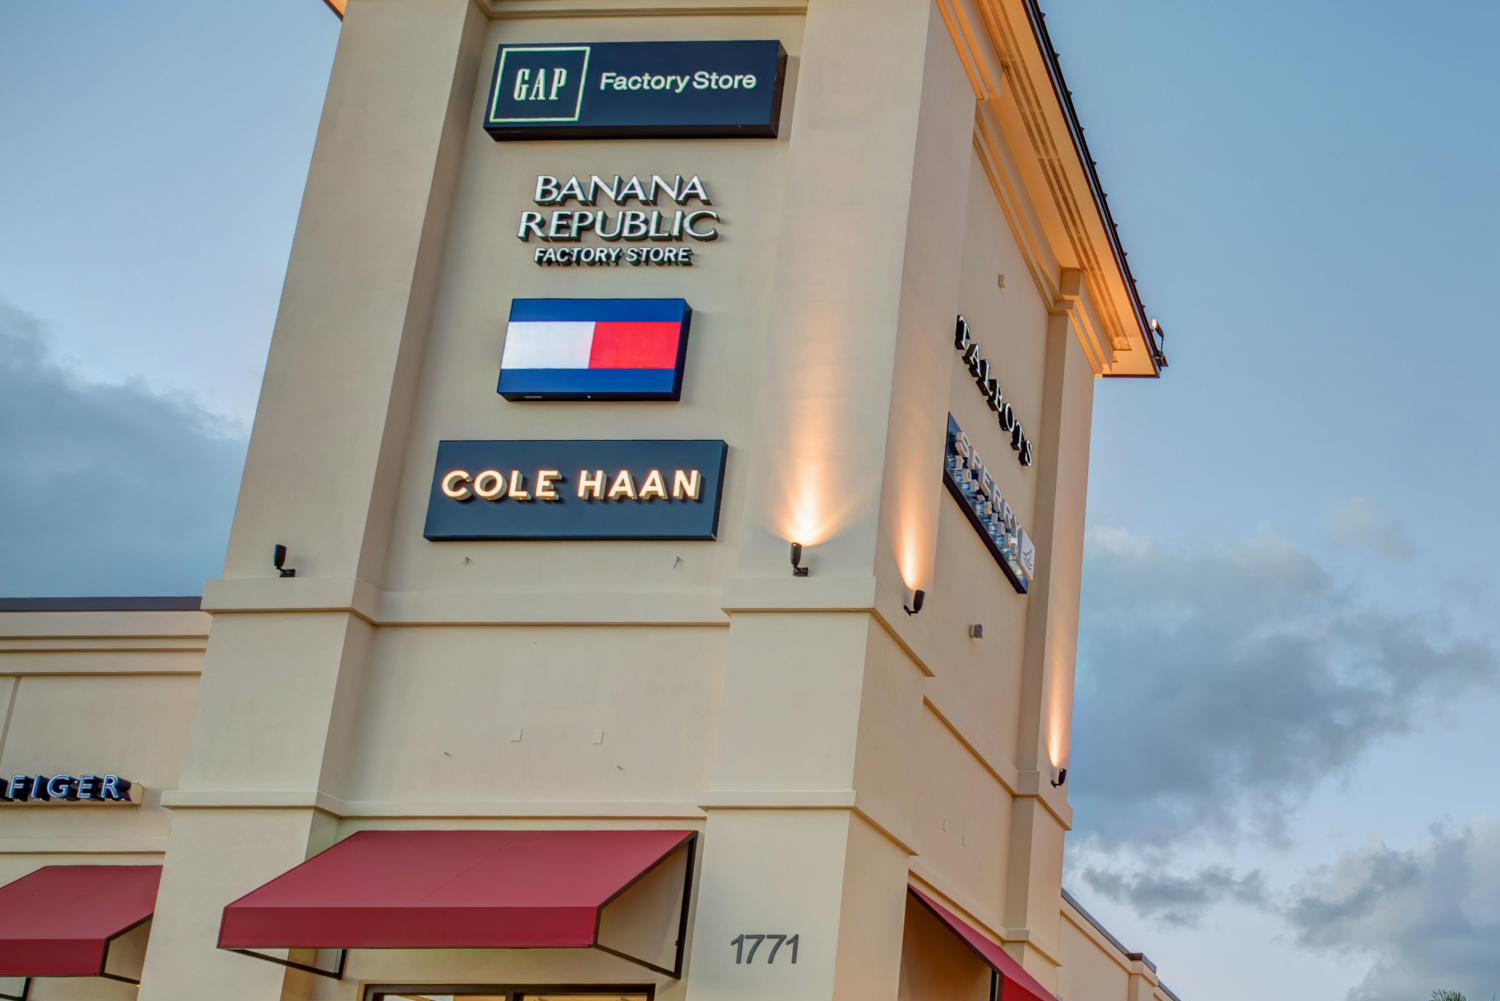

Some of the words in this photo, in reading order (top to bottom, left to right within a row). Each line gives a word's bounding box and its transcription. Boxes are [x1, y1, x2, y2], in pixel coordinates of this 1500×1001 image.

[513, 68, 567, 101] GAP
[600, 72, 689, 93] Factory
[692, 71, 757, 90] Store
[534, 174, 710, 204] BANANA
[517, 210, 719, 240] REPUBLIC
[534, 247, 621, 264] FACTORY
[626, 247, 691, 264] STORE
[954, 314, 1033, 468] TALBOTS
[441, 470, 560, 500] COLE
[577, 470, 701, 500] HAAN
[730, 933, 799, 964] 1771
